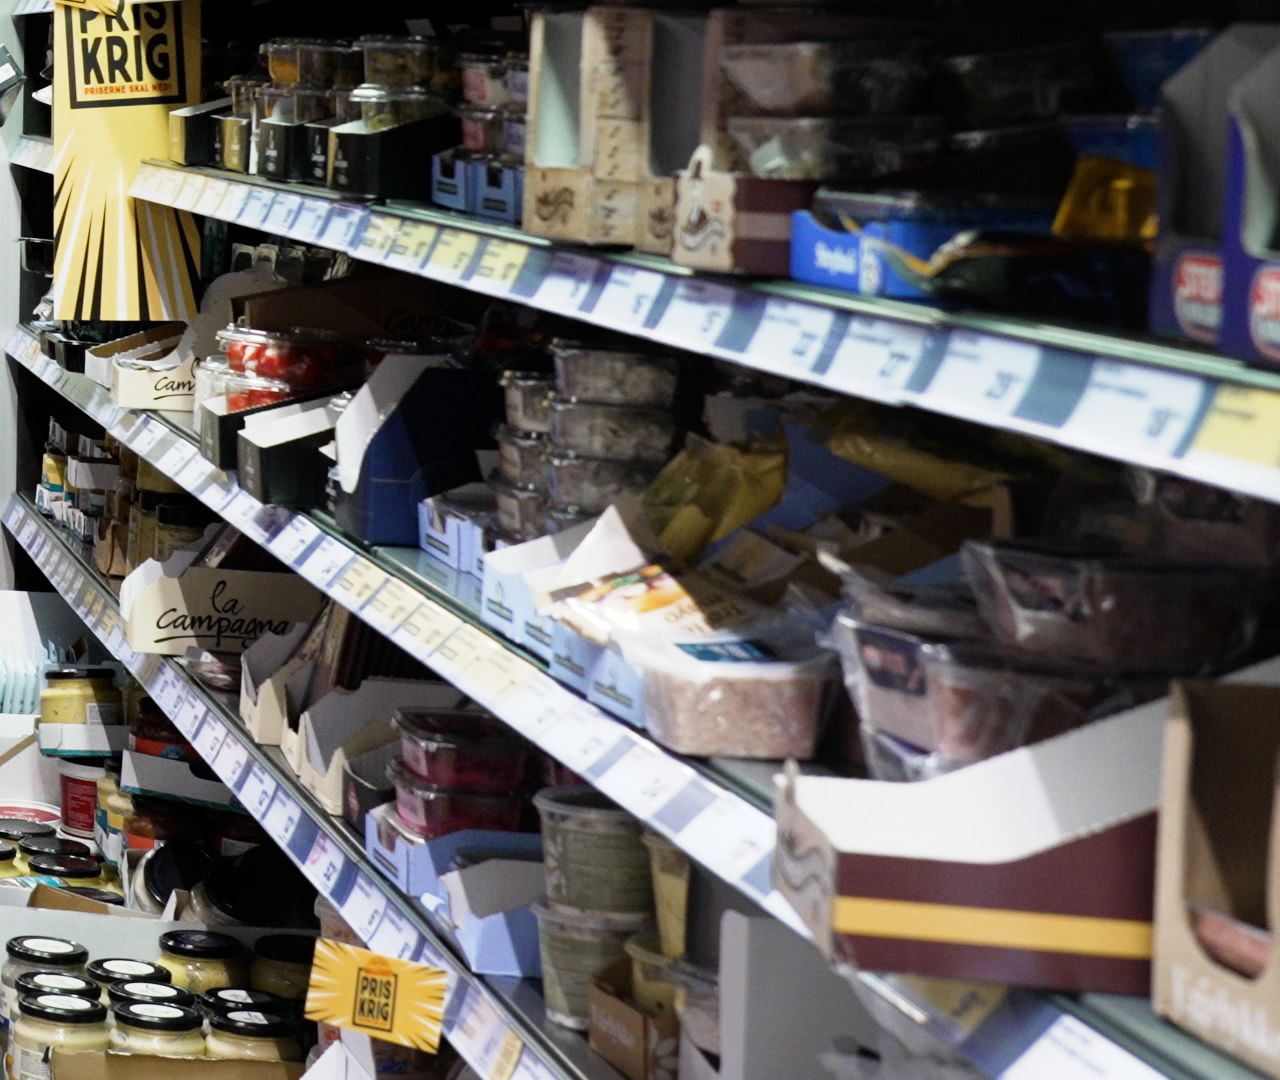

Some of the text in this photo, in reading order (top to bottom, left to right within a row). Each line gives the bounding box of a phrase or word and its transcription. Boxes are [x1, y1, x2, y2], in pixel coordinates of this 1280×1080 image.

[81, 33, 171, 85] KRIG
[84, 85, 127, 95] PRISERNE
[129, 83, 149, 93] SKAL
[211, 579, 245, 616] la
[155, 607, 291, 649] Campagna
[360, 974, 392, 998] PRIS
[357, 998, 390, 1021] KRIG
